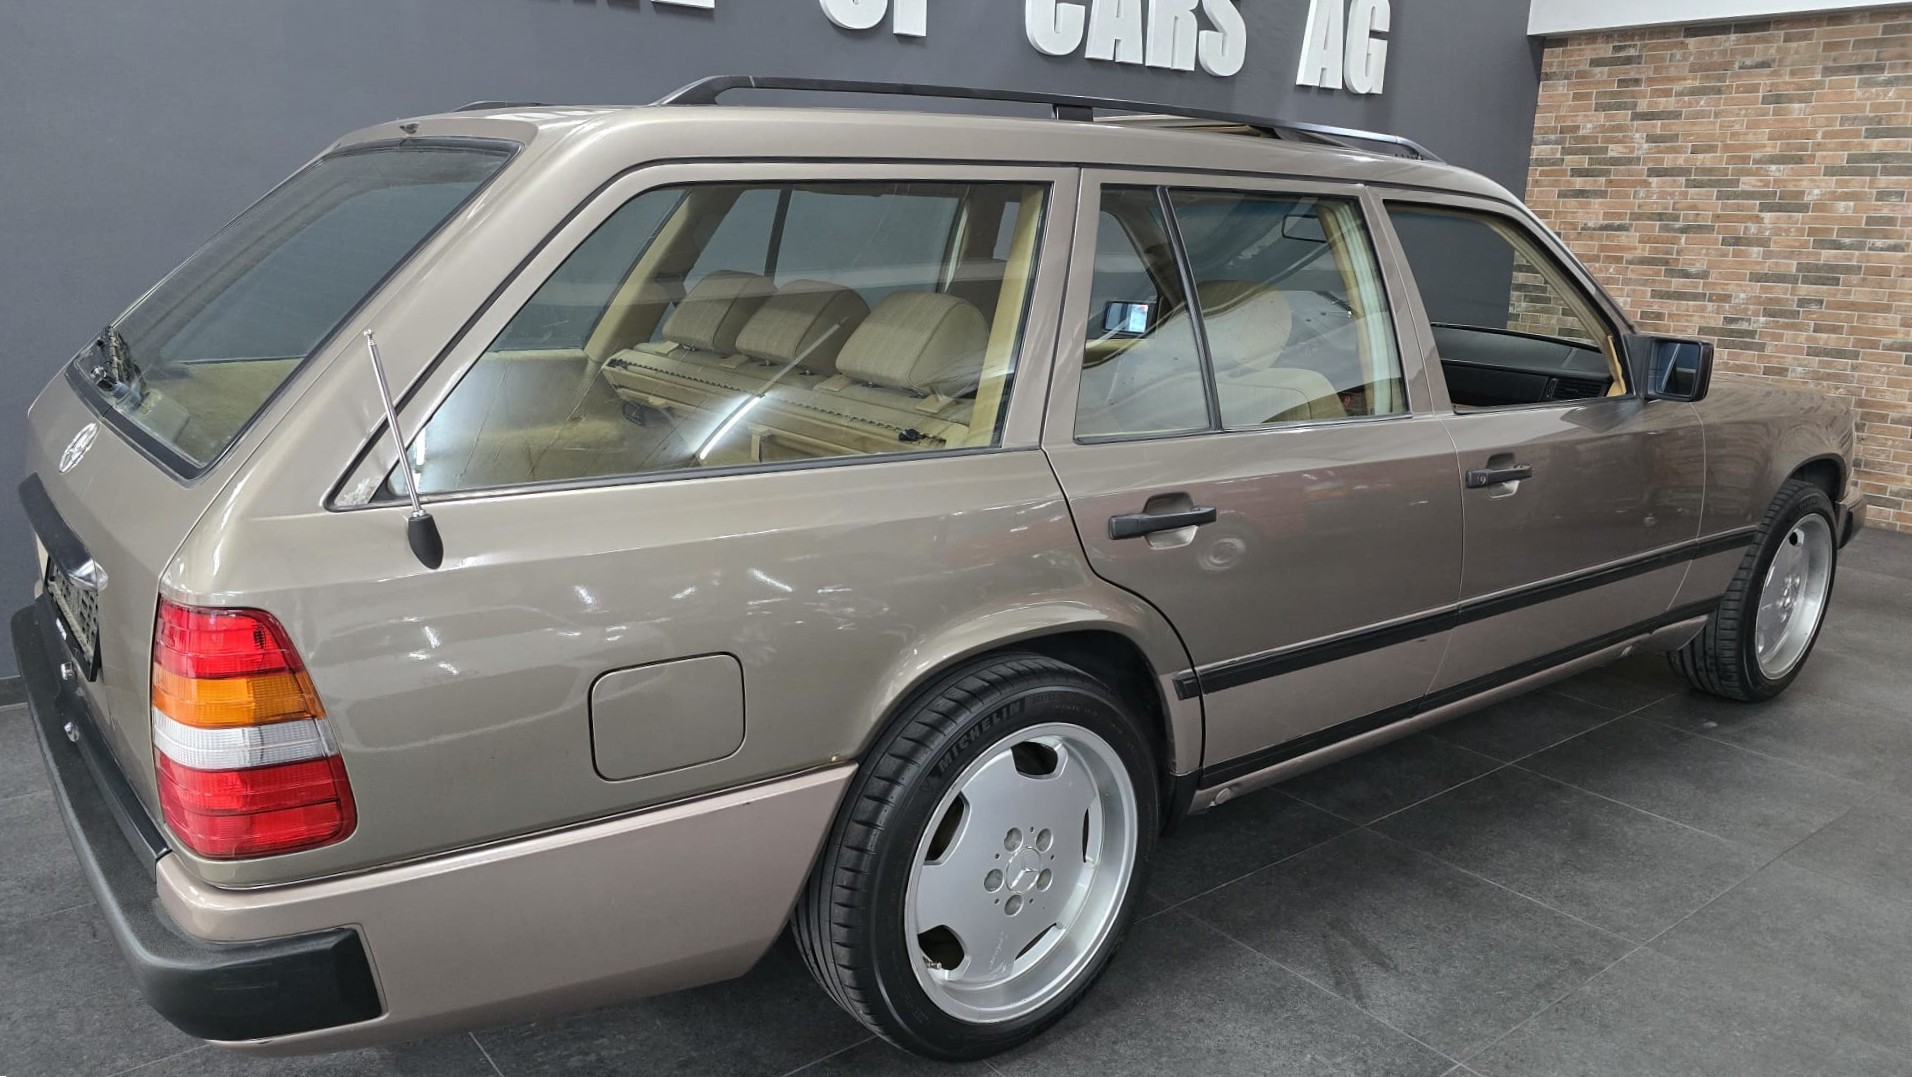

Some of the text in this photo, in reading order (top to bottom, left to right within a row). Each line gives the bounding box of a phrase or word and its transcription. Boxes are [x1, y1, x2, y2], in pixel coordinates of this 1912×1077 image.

[1025, 0, 1247, 77] CARS
[1296, 0, 1391, 95] AG
[938, 701, 1021, 772] MICHELIN
